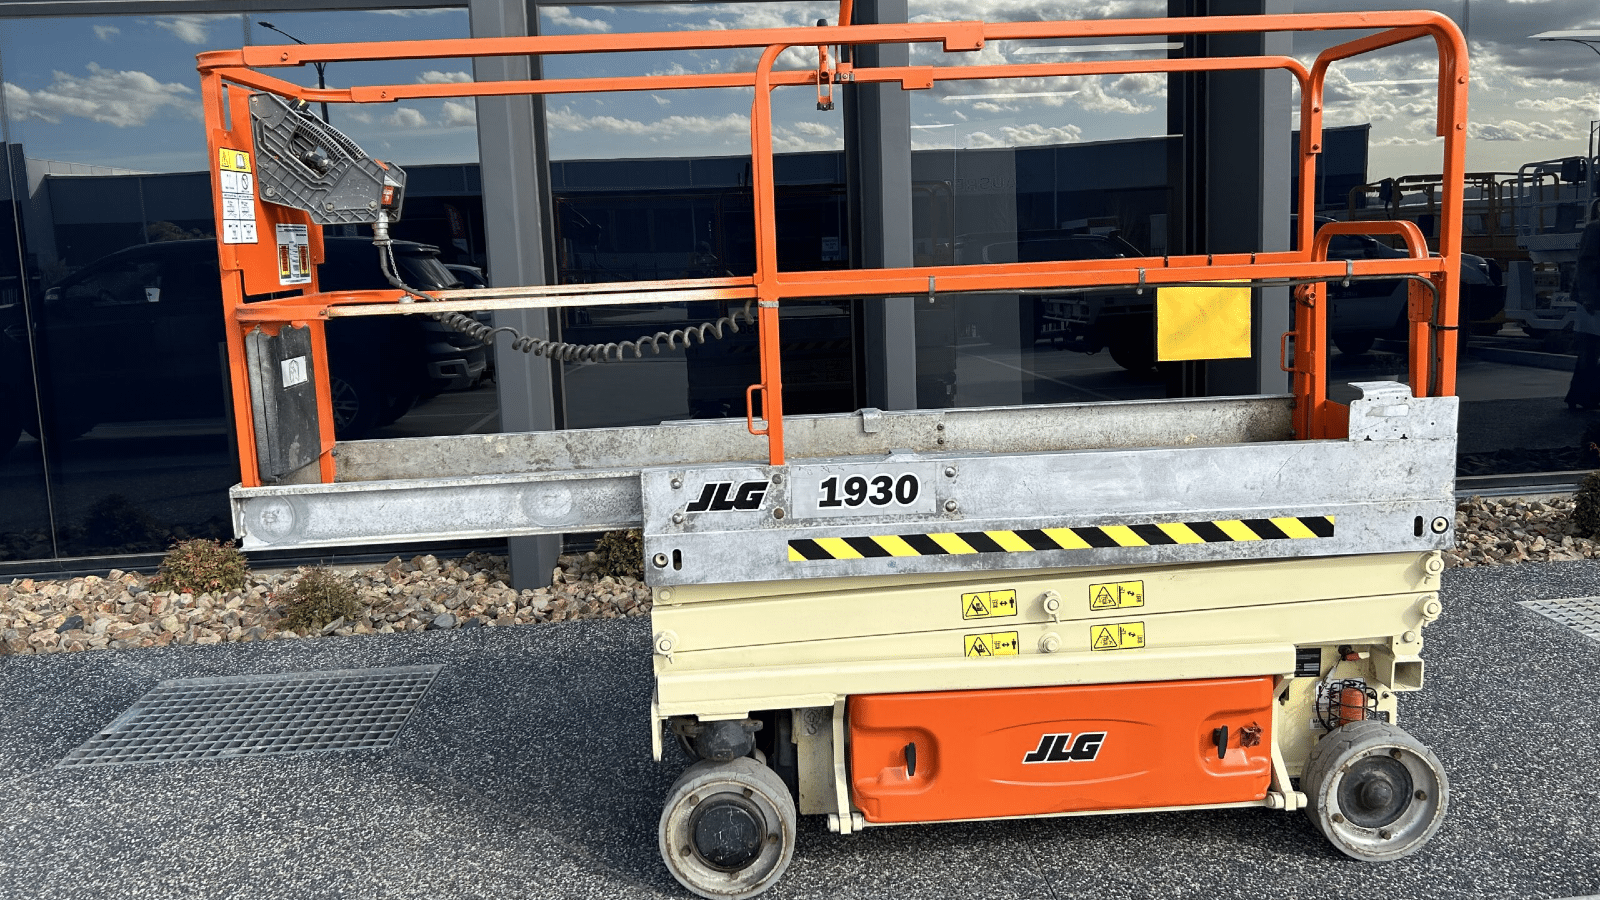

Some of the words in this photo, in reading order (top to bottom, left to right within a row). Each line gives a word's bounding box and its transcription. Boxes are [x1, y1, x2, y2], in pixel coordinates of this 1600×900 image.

[686, 481, 769, 512] JLG
[818, 473, 920, 509] 1930
[1022, 732, 1106, 764] JLG
